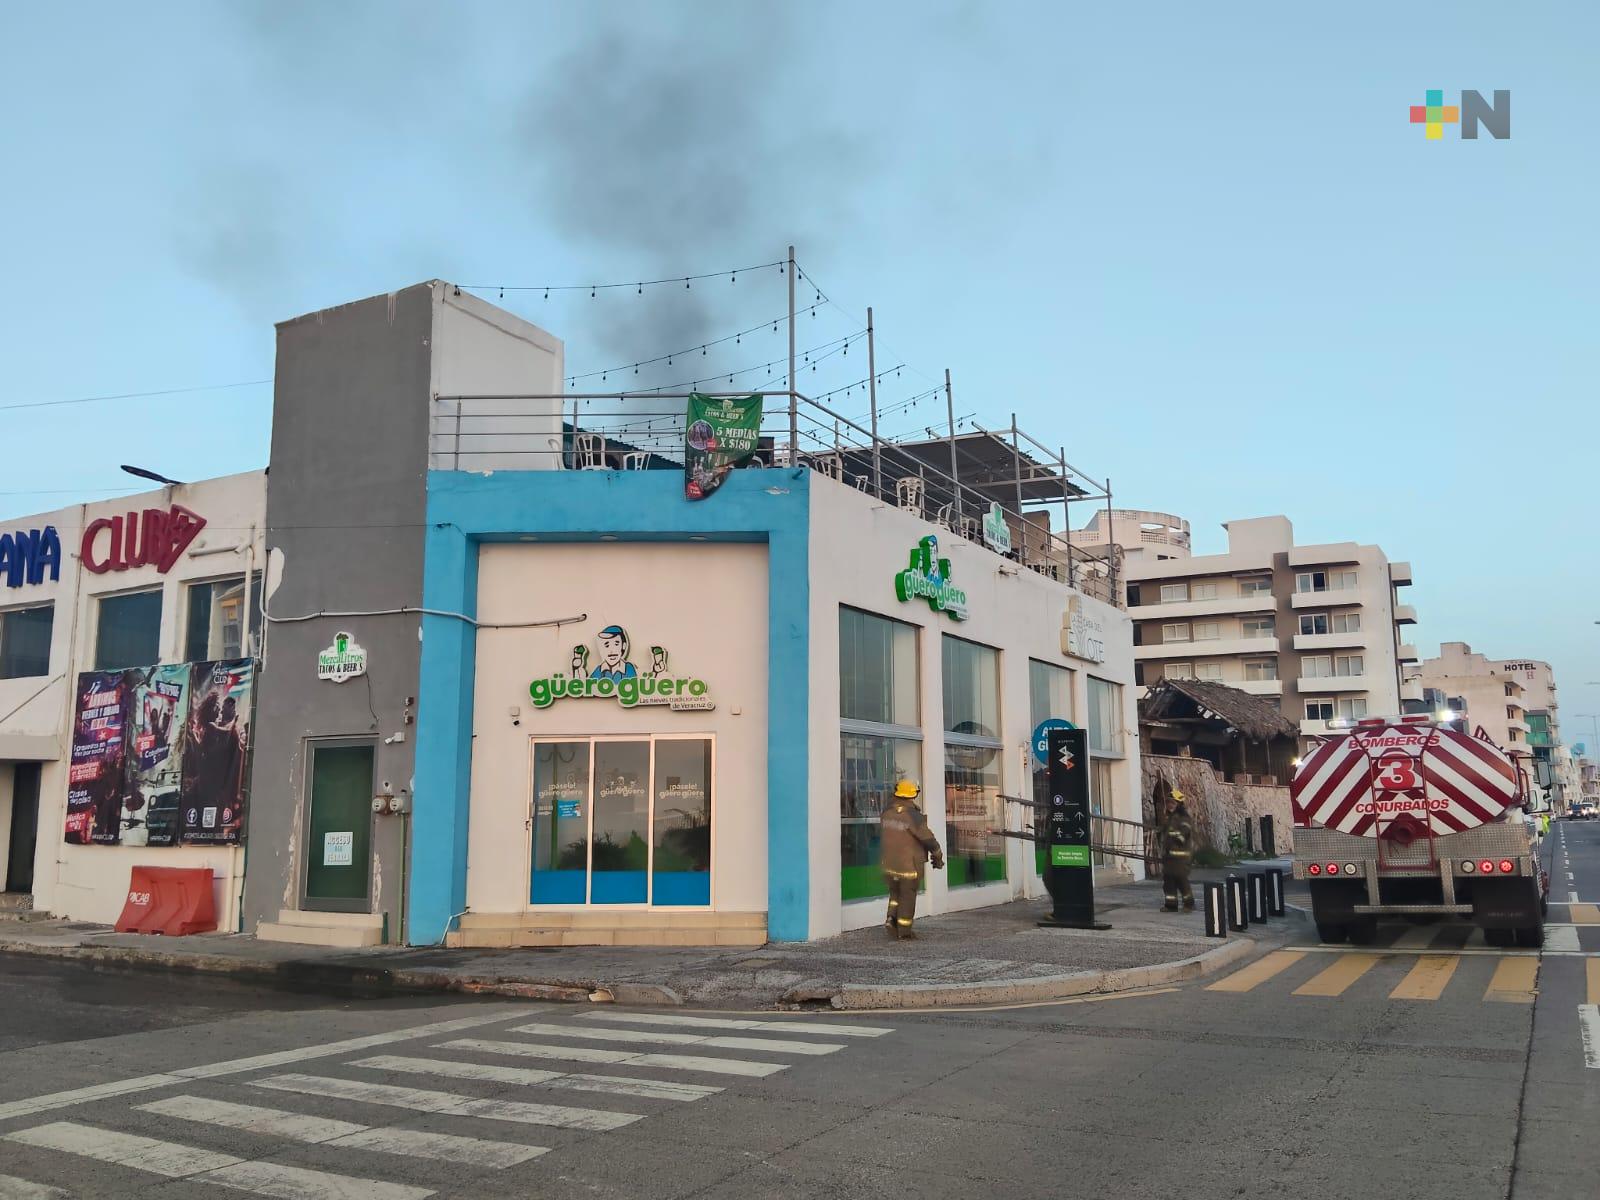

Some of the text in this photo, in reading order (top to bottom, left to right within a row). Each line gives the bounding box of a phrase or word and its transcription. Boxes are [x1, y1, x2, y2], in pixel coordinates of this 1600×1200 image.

[716, 427, 757, 440] 5 MEDIAS
[719, 438, 726, 447] X
[729, 439, 751, 450] $180
[319, 664, 335, 674] TACOS
[1504, 663, 1536, 671] HOTEL
[1348, 733, 1441, 750] BOMBEROS
[1378, 754, 1416, 792] 3
[1355, 799, 1449, 814] CONURBADOS
